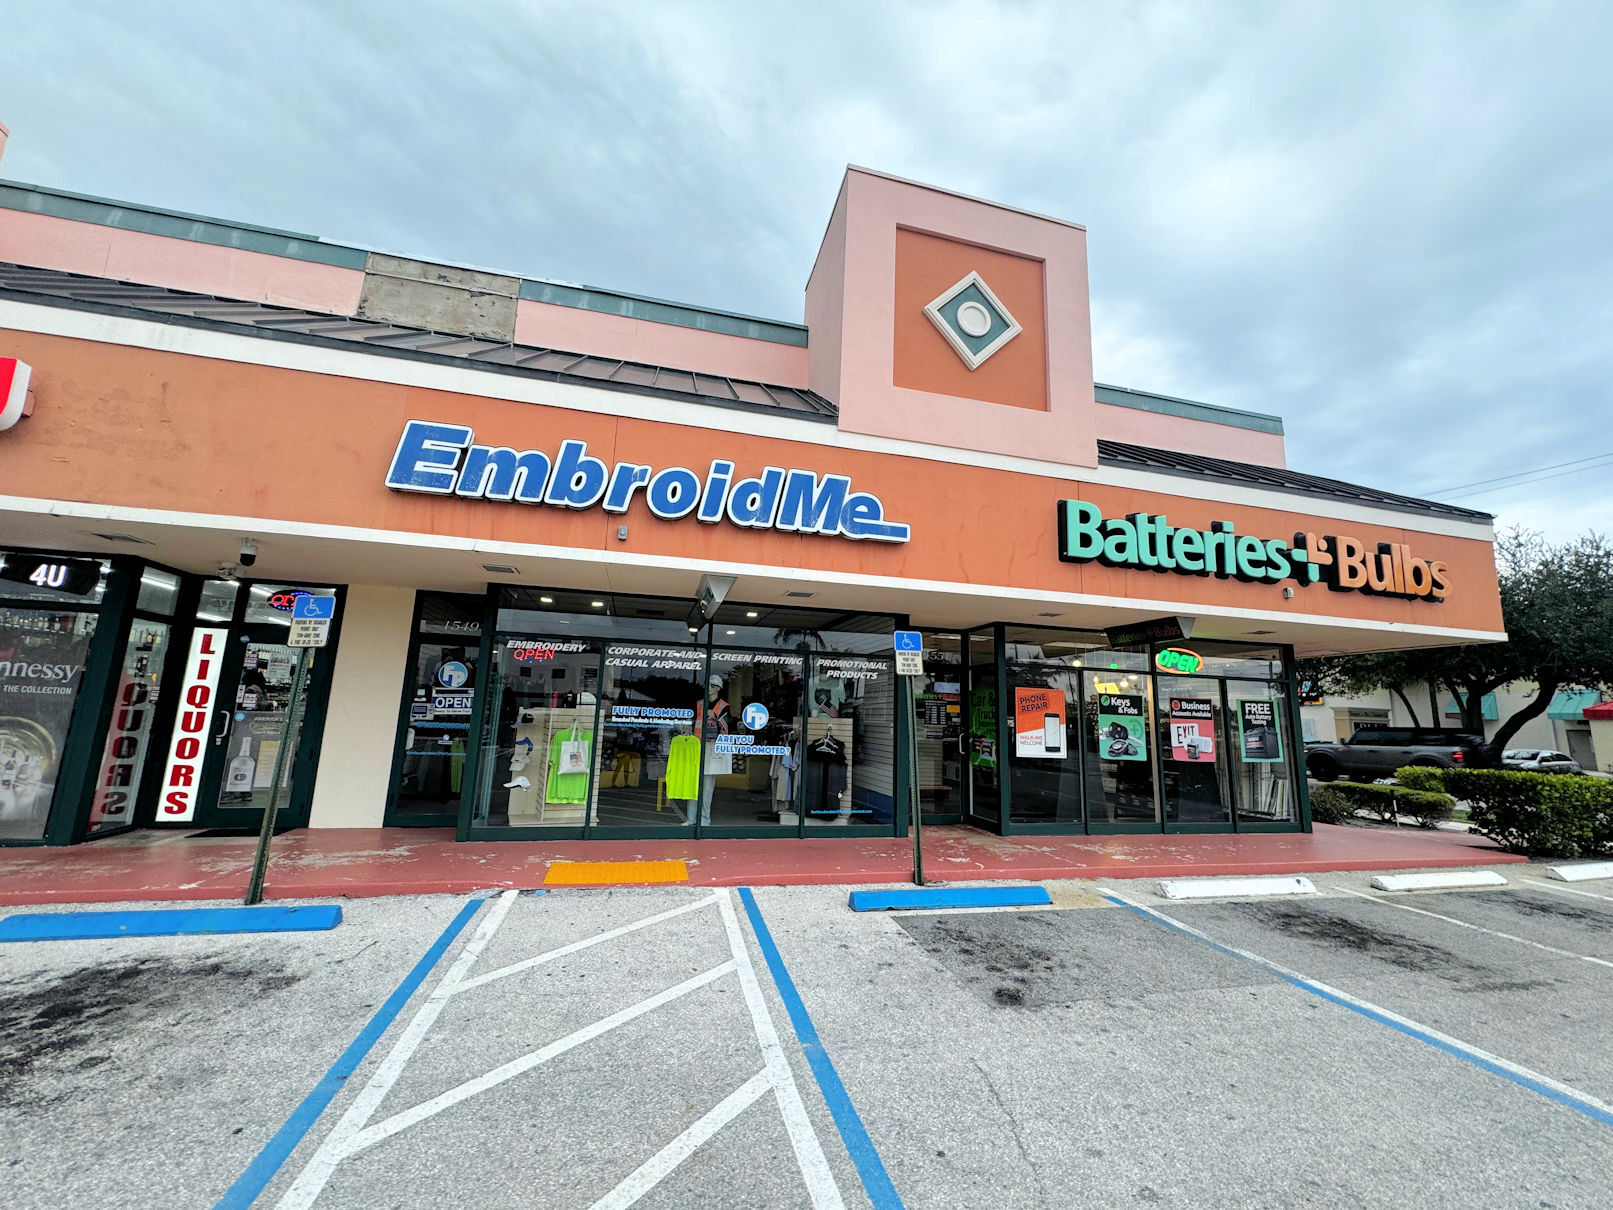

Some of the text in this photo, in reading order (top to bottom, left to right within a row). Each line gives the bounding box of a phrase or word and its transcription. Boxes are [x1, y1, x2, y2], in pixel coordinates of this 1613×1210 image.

[385, 419, 911, 542] EmbroidMe
[1060, 499, 1291, 581] Batteries
[1334, 535, 1453, 600] Bulbs
[29, 563, 68, 587] 4U
[507, 640, 586, 652] EMBROIDERY
[513, 649, 555, 660] OPEN
[608, 646, 702, 659] CORPORATE AND
[605, 658, 702, 670] CASUAL APPAREL
[711, 653, 803, 665] SCREEN PRINTING
[817, 659, 887, 670] PROMOTIONAL
[1157, 649, 1199, 673] OPEN
[826, 670, 878, 680] PRODUCTS
[4, 684, 72, 695] THE COLLECTION
[435, 697, 471, 708] OPEN
[1019, 693, 1047, 704] PHONE
[1110, 697, 1131, 708] Keys
[612, 705, 694, 718] FULLY PROMOTED
[1021, 701, 1048, 712] REPAIR
[1124, 706, 1139, 714] Fobs
[1181, 701, 1210, 711] Business
[1244, 703, 1271, 714] FREE
[746, 706, 767, 728] FP
[164, 634, 215, 814] LIQUORS
[716, 734, 754, 744] ARE YOU
[1176, 725, 1194, 744] EXIT
[715, 744, 791, 755] FULLY PROMOTED?
